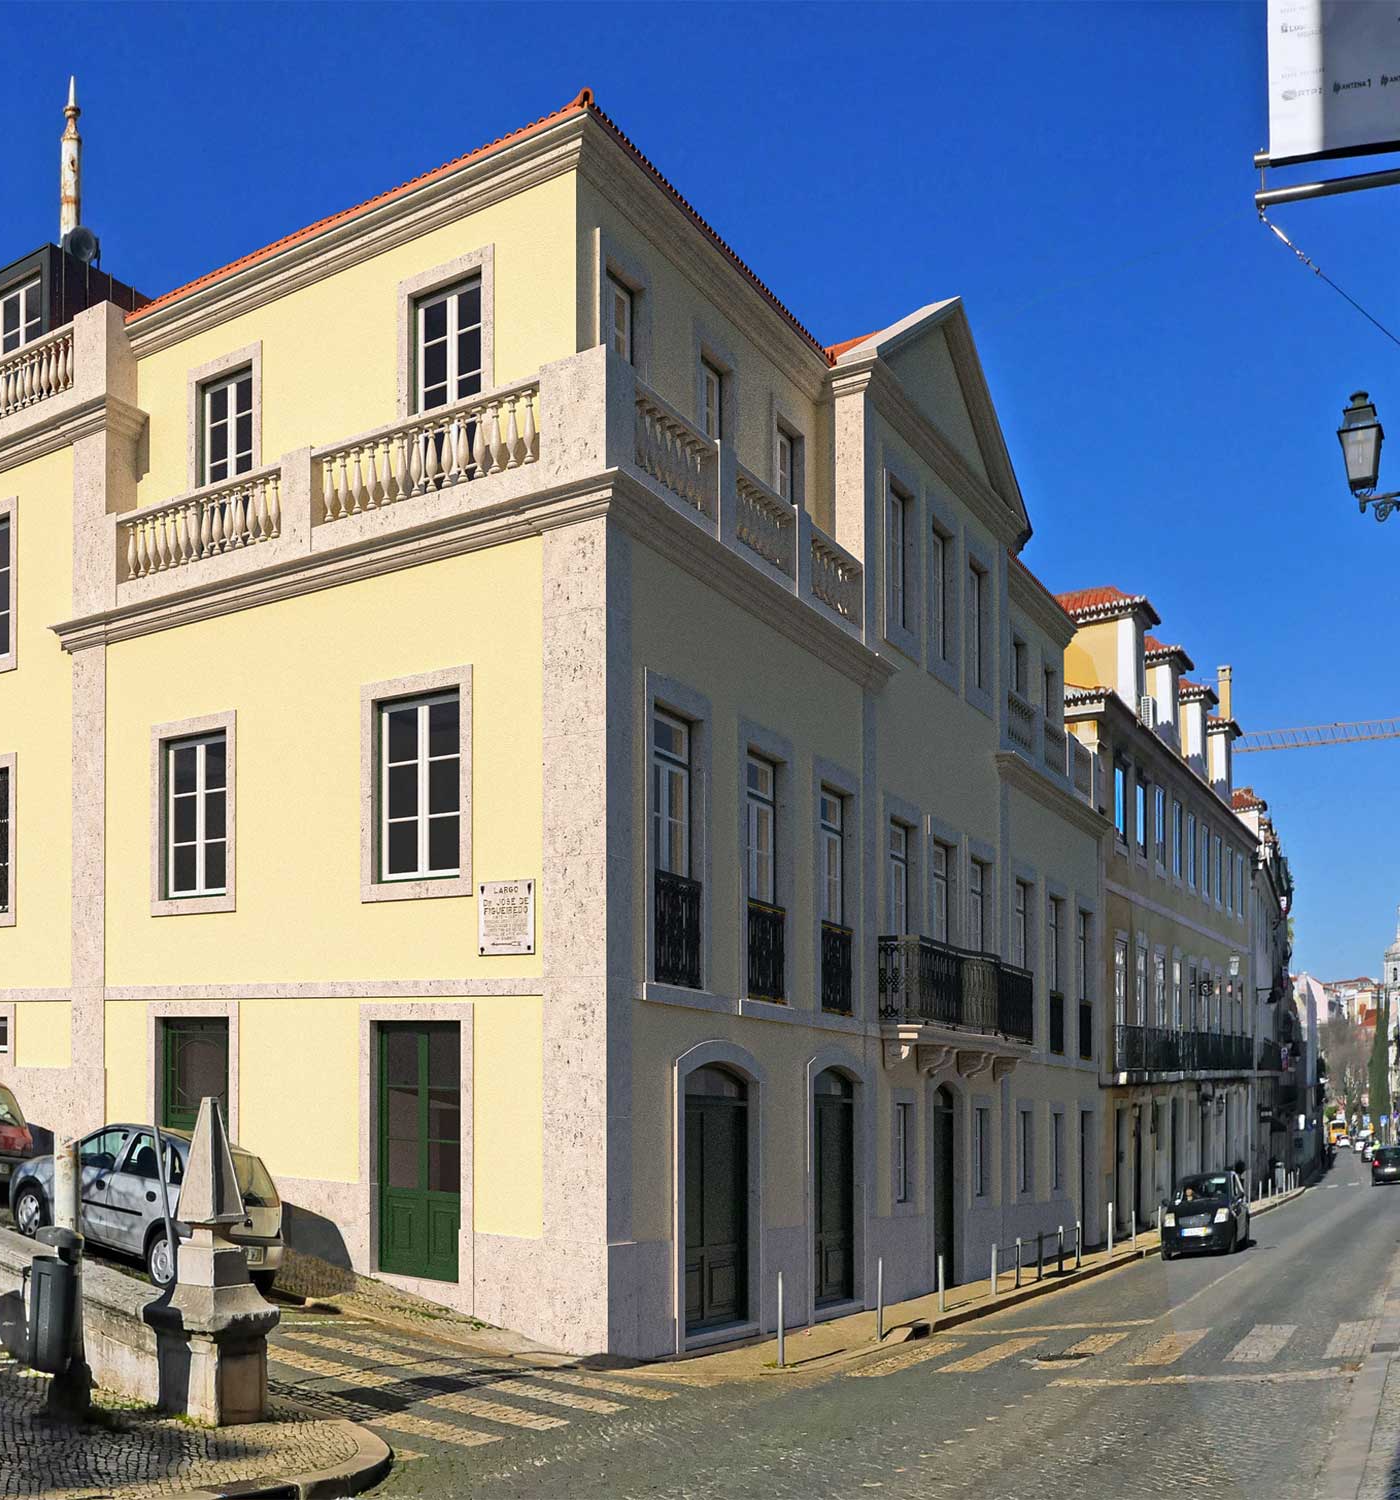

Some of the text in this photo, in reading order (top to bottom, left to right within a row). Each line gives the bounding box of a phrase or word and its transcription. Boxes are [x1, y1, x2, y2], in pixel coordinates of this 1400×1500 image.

[1341, 81, 1366, 90] ANTENA
[493, 886, 519, 894] LARGO
[519, 897, 529, 905] DE
[483, 906, 529, 915] FIGUEIREDO
